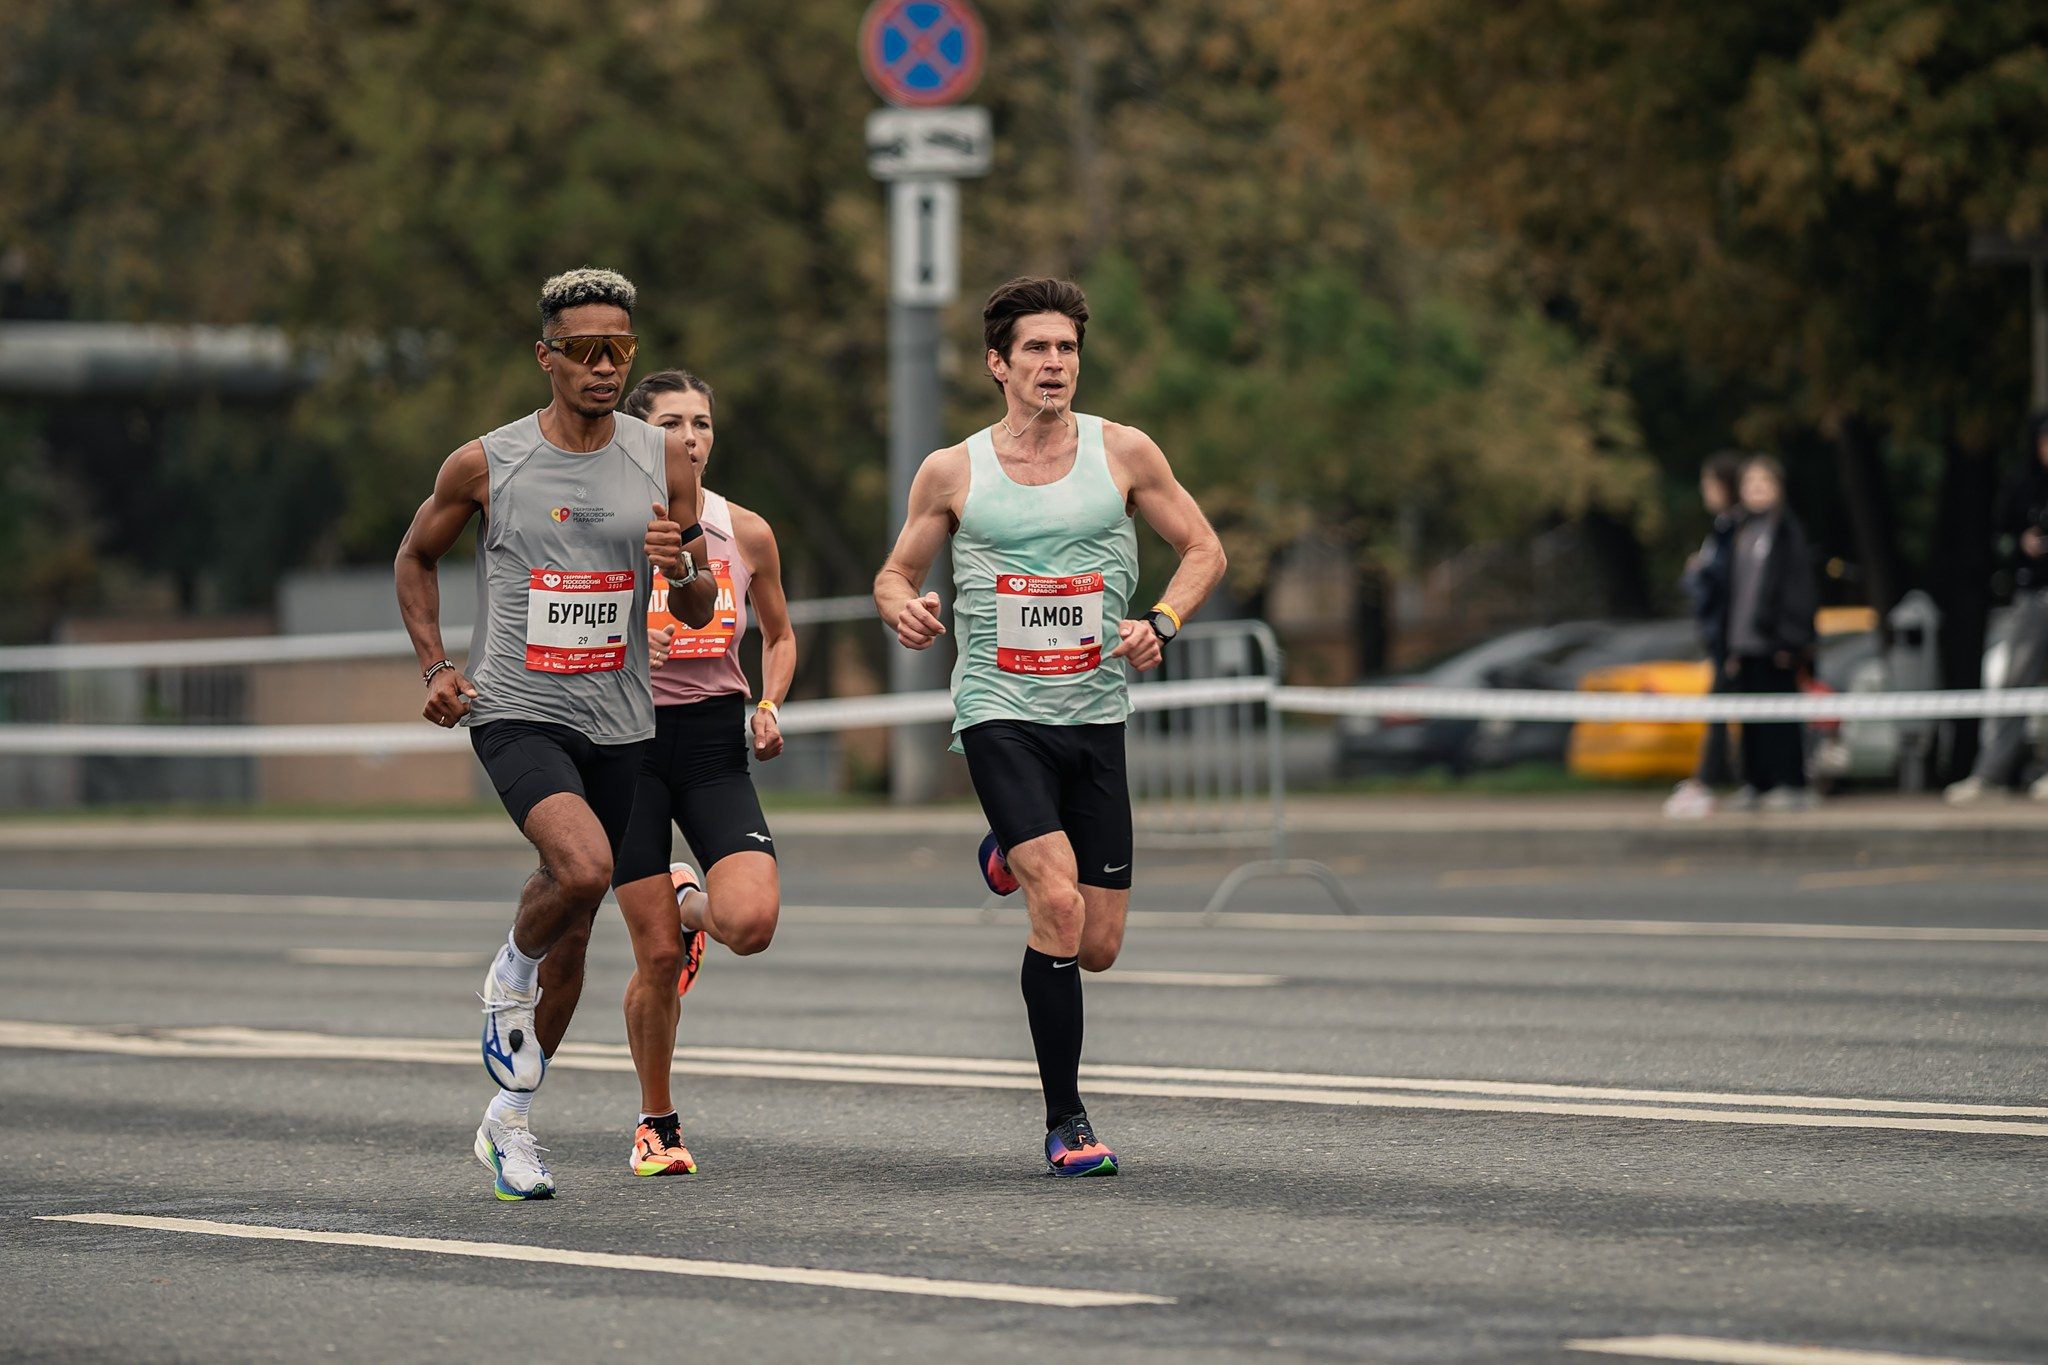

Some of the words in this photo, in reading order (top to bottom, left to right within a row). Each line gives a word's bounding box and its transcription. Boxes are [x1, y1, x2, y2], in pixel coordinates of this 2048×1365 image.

[548, 602, 618, 628] БУРЦЕВ
[1021, 606, 1083, 627] ГАМОВ
[578, 636, 588, 645] 29
[1047, 638, 1058, 646] 19
